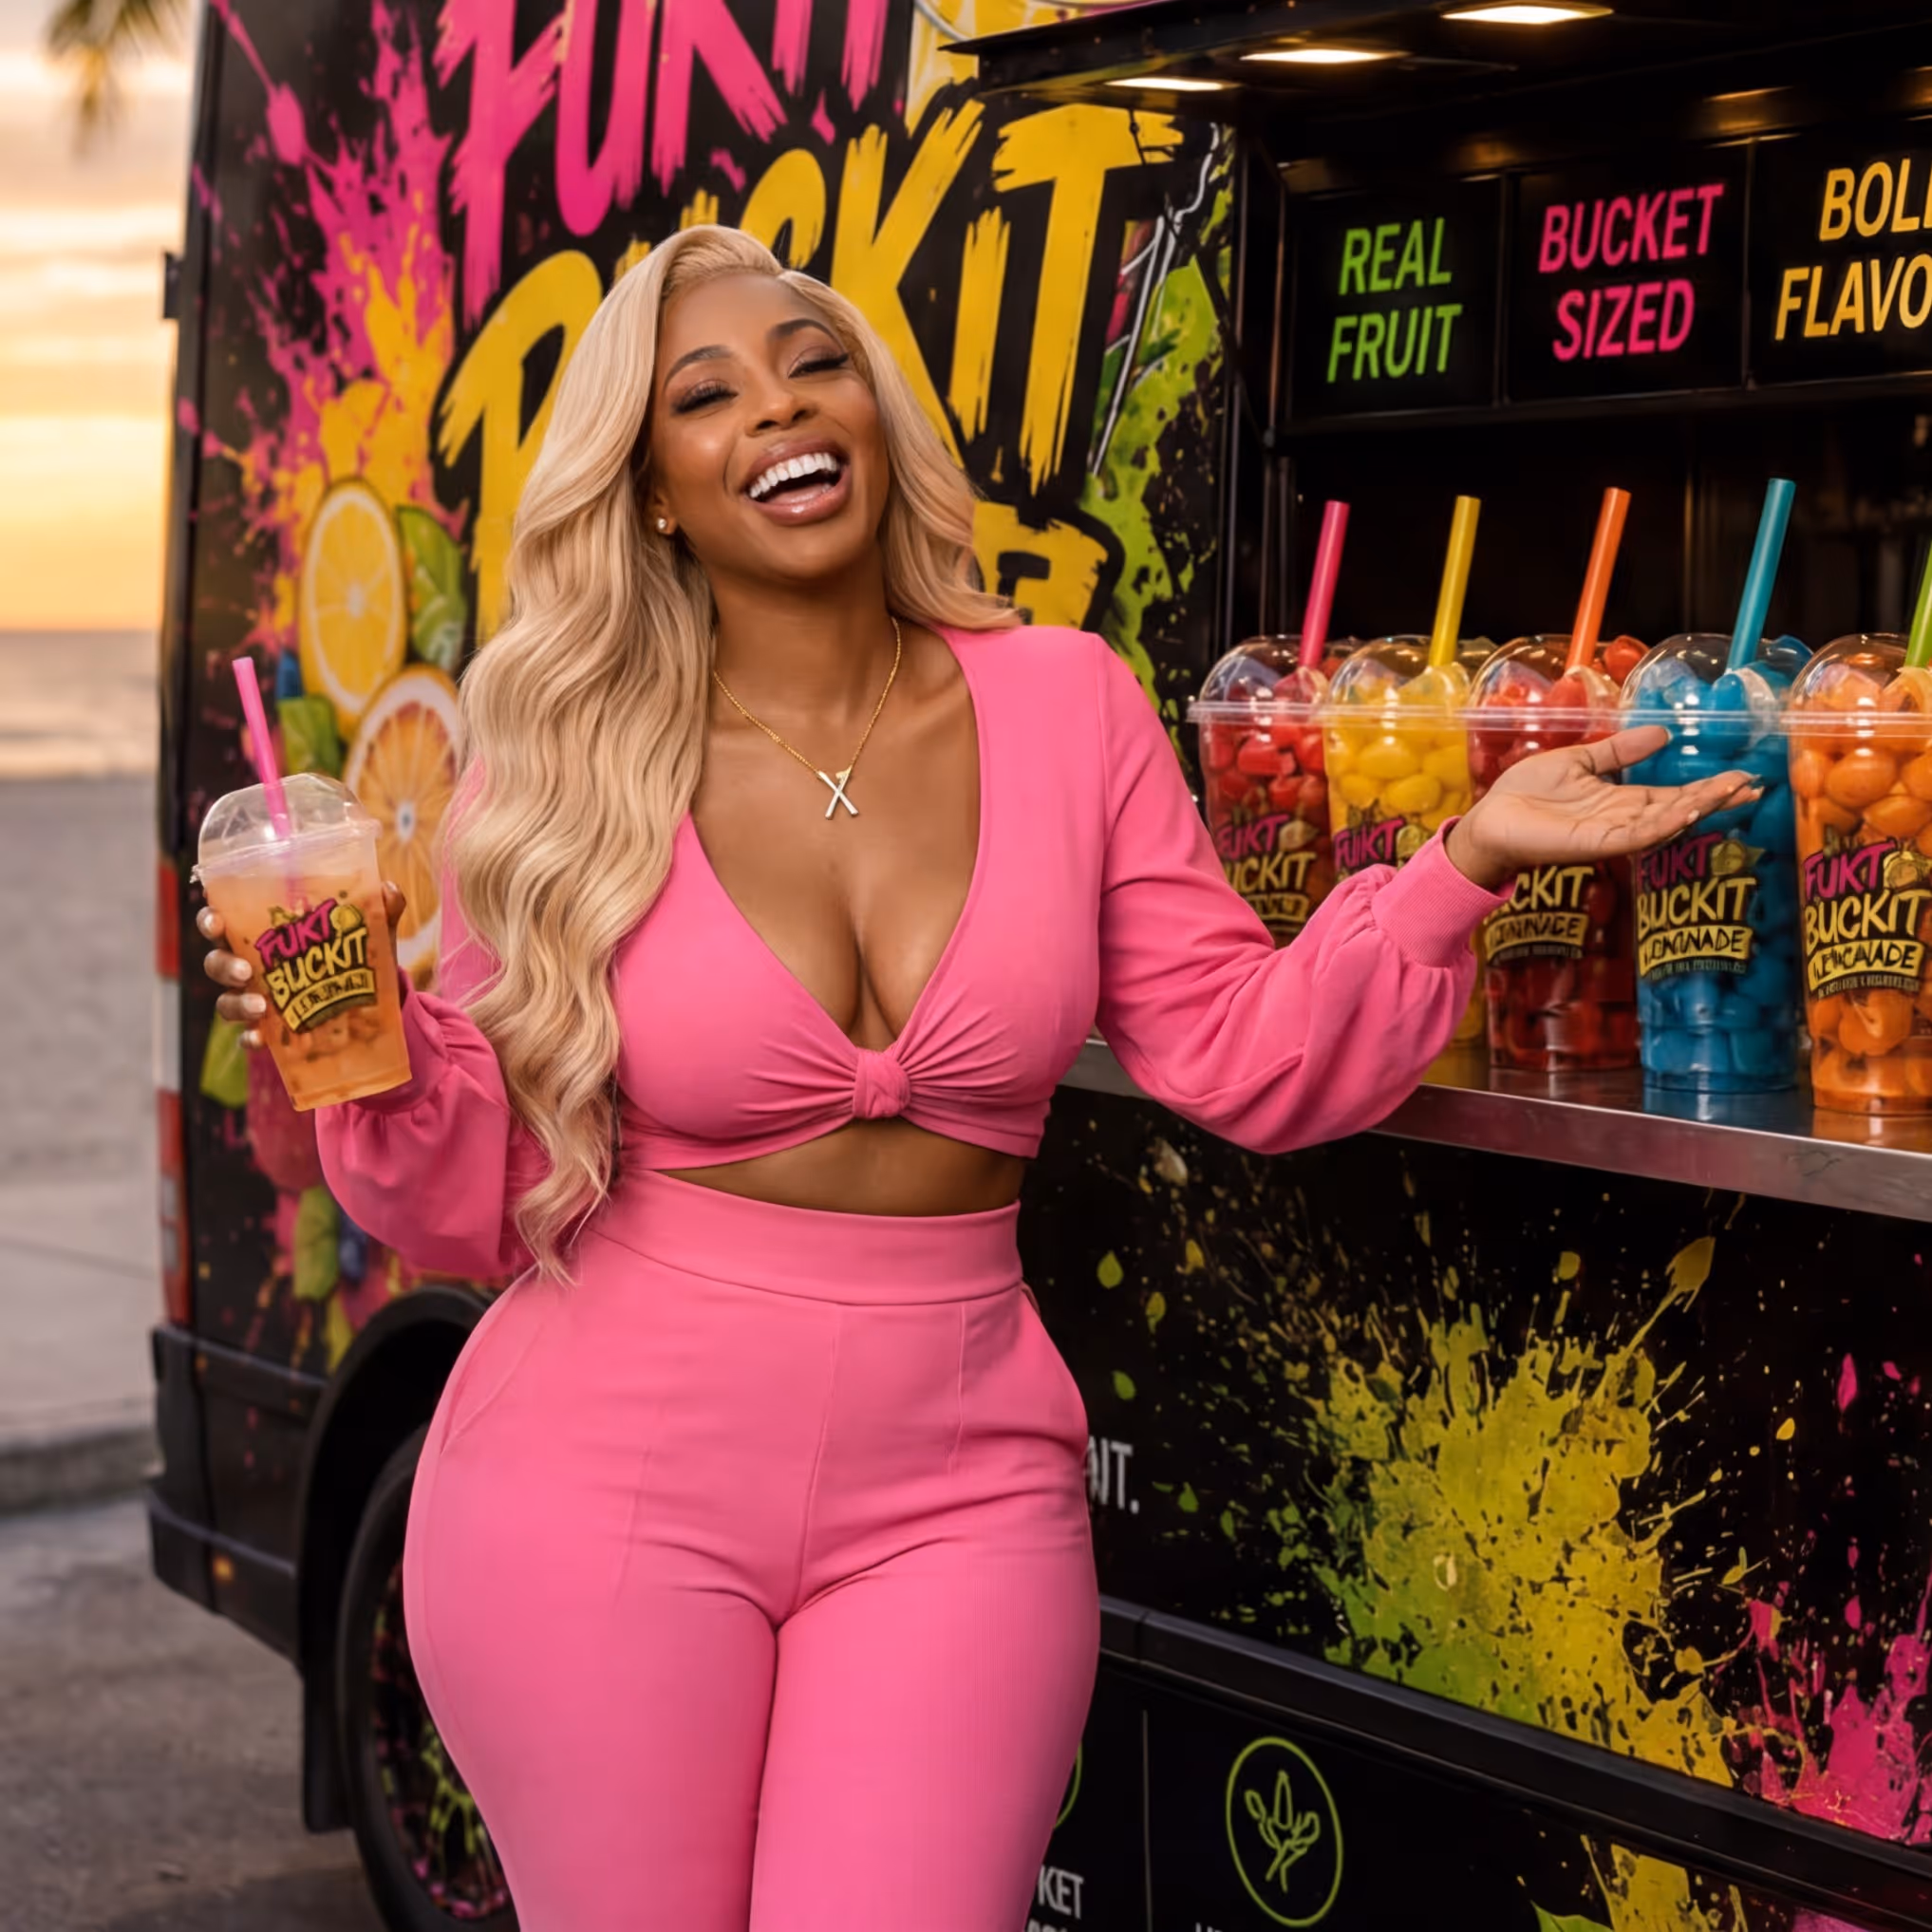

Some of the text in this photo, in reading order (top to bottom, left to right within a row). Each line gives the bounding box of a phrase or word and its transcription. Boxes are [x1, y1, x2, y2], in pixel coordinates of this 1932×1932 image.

[1538, 184, 1725, 274] BUCKET
[1819, 159, 1932, 242] BOL
[1339, 216, 1453, 296] REAL
[1327, 304, 1462, 384] FRUIT
[1552, 279, 1696, 362] SIZED
[1483, 865, 1595, 925] CKIT
[1637, 876, 1756, 942] BUCKIT
[1804, 839, 1896, 900] FUKT
[255, 899, 337, 969] FUKT
[1805, 888, 1932, 956] BUCKIT
[266, 926, 366, 1010] BUCKIT
